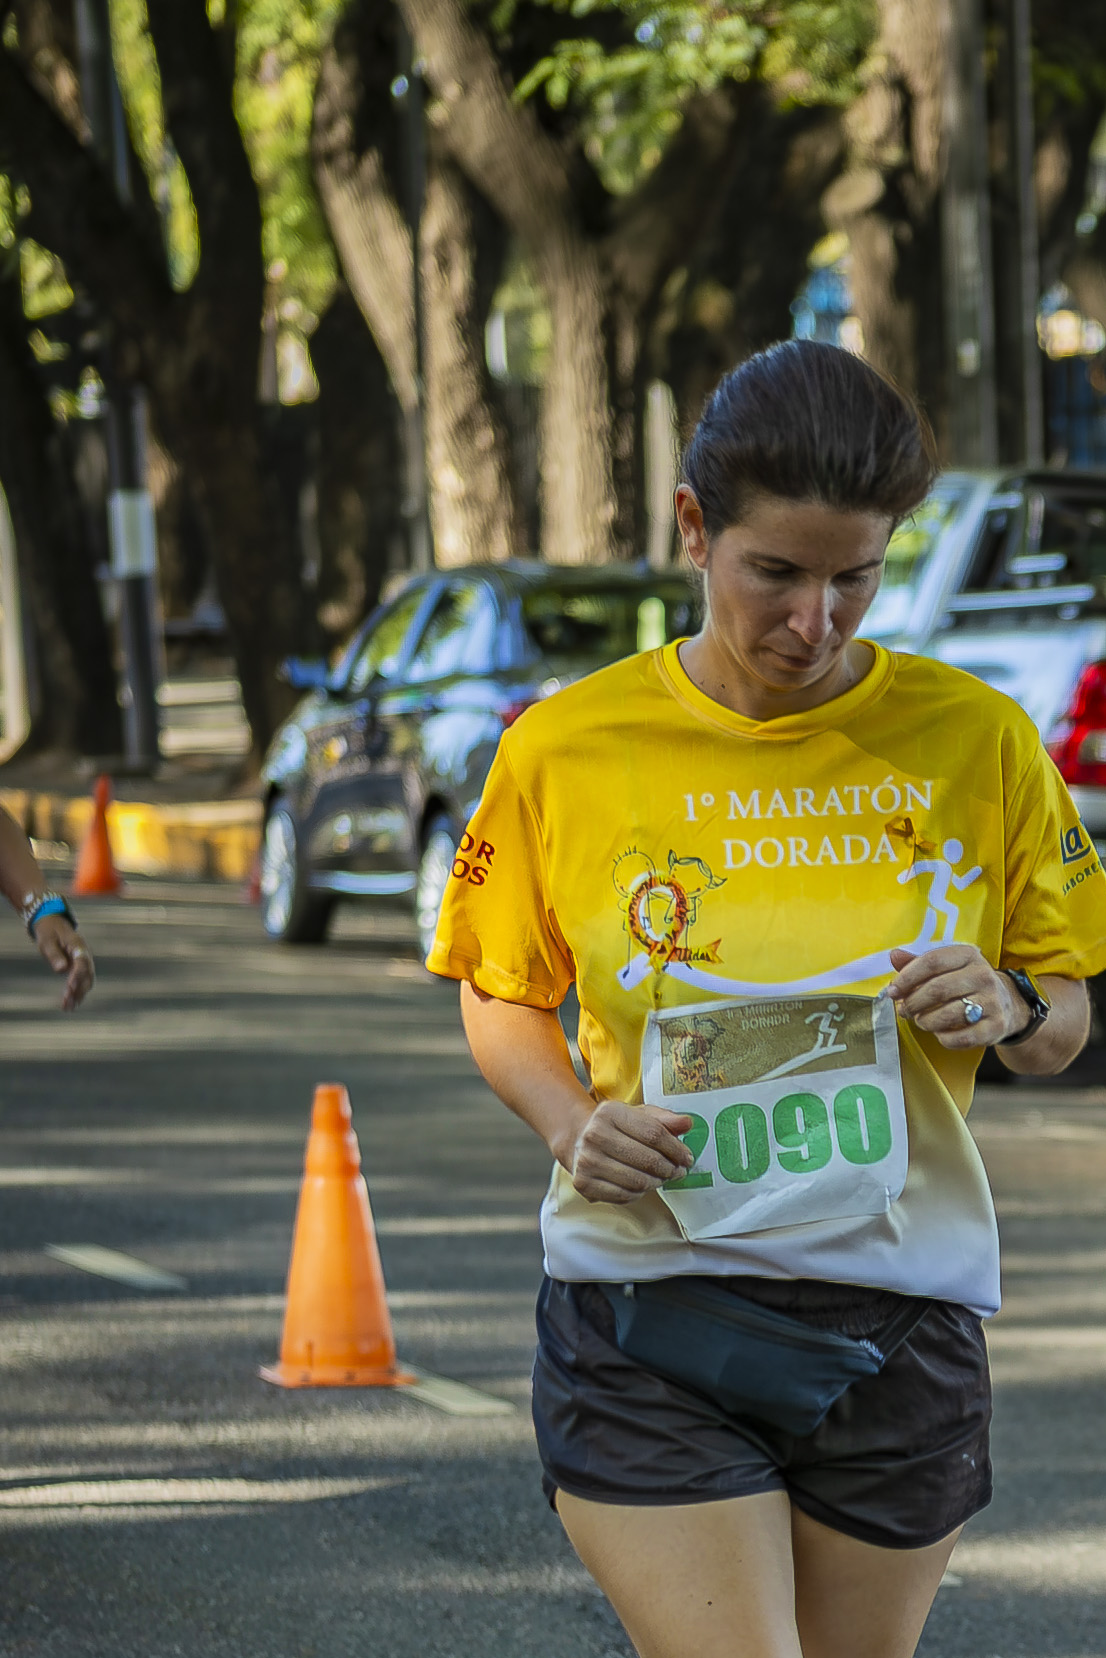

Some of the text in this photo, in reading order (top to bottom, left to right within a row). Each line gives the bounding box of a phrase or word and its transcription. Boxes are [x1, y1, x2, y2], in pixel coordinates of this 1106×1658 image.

[726, 775, 934, 821] MARATÓN
[722, 834, 899, 869] DORADA
[1062, 861, 1101, 896] SABORE
[662, 1083, 893, 1191] 2090
